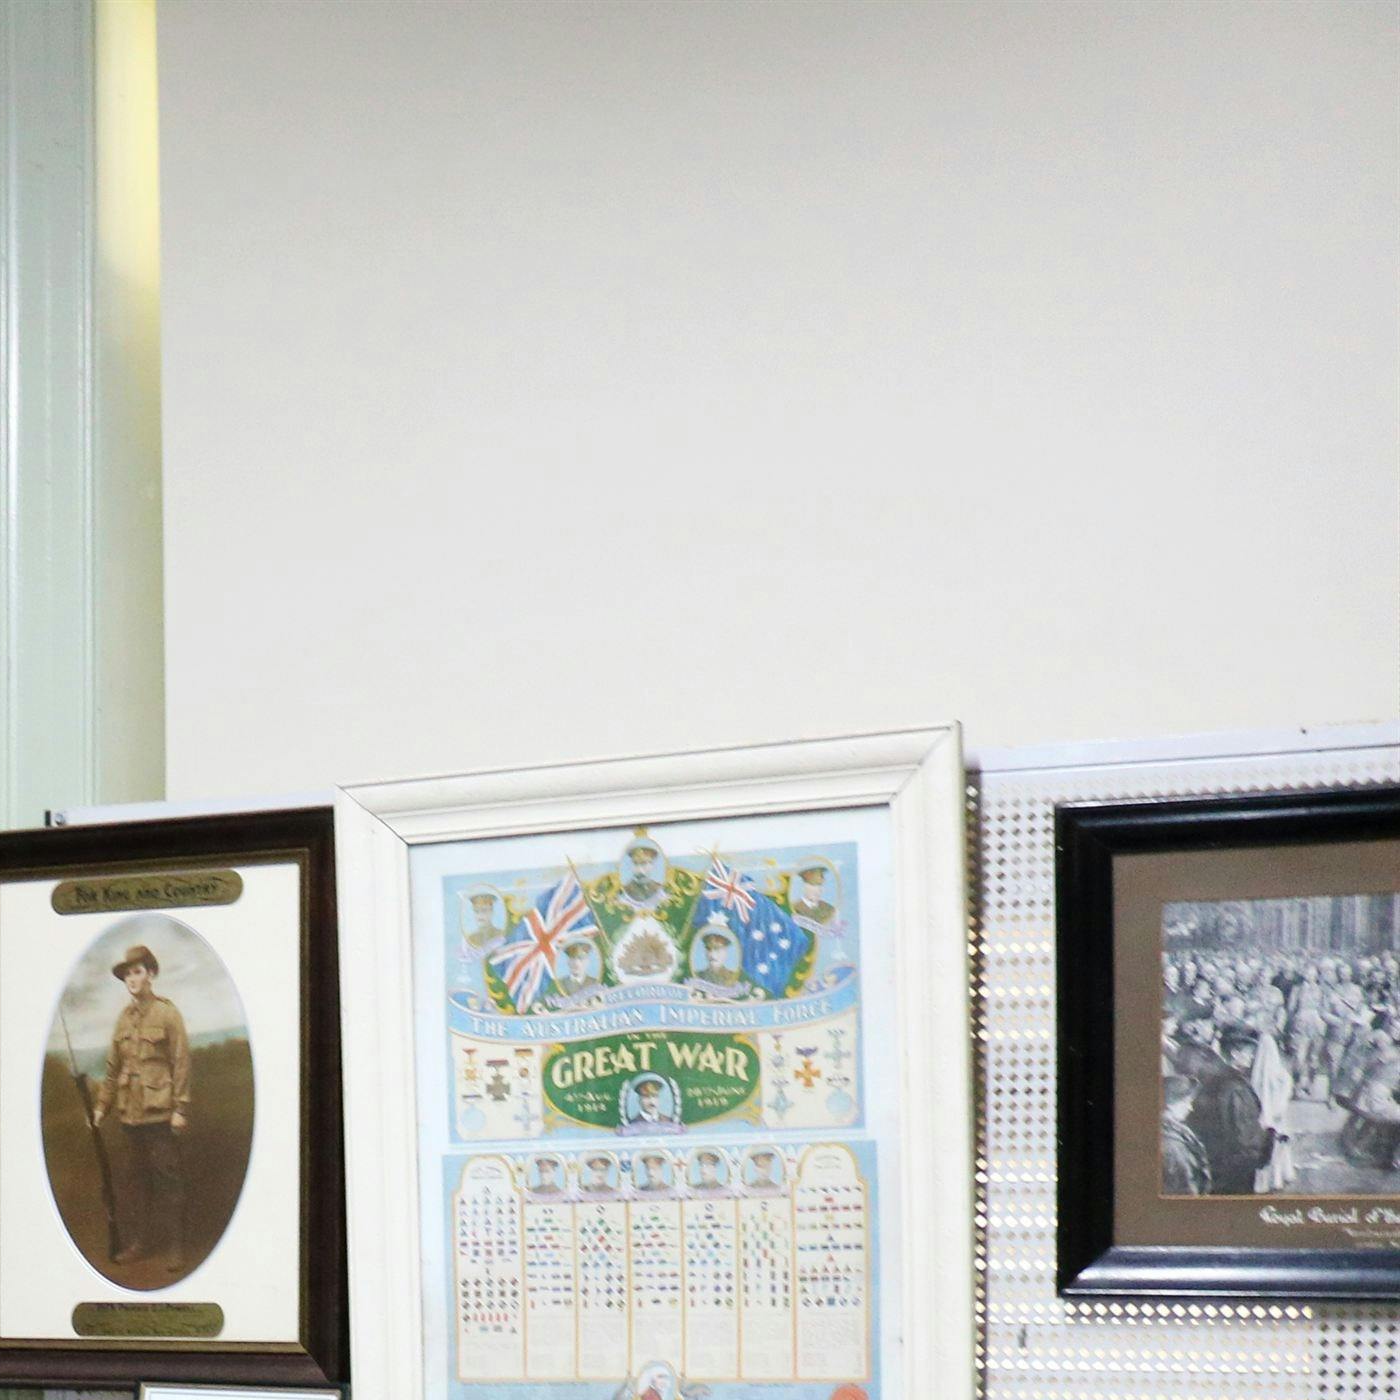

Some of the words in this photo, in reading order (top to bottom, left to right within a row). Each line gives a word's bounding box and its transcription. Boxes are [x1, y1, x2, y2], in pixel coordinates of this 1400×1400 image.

[471, 1016, 507, 1038] THE
[522, 1007, 645, 1039] AUSTRALIAN
[659, 1003, 755, 1026] IMPERIAL
[772, 999, 831, 1024] FORCE
[551, 1041, 658, 1090] GREAT
[667, 1039, 750, 1083] WAR
